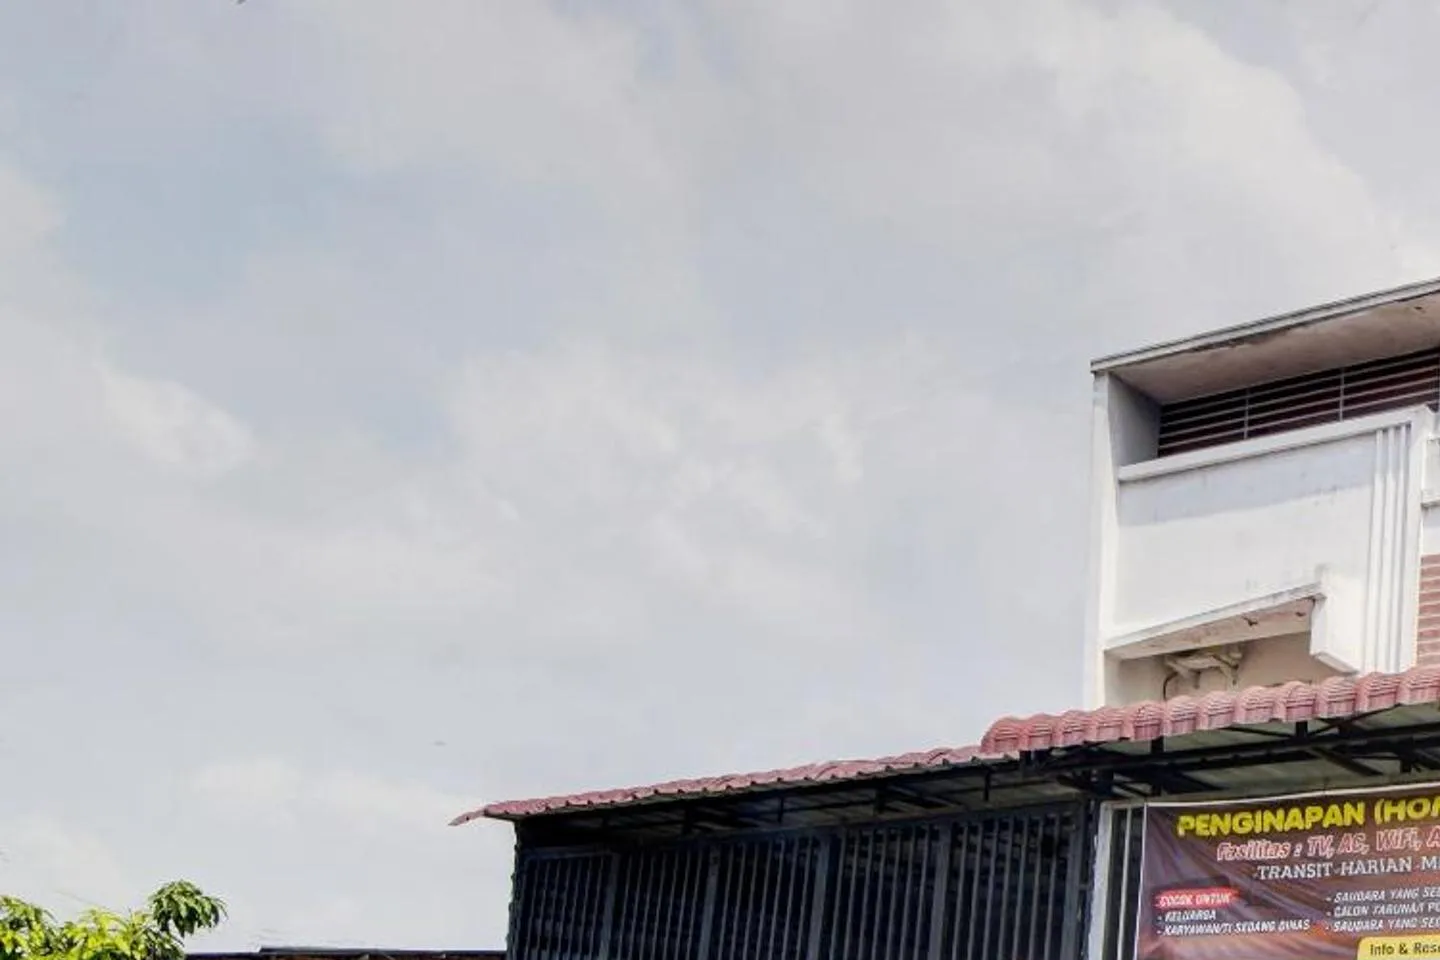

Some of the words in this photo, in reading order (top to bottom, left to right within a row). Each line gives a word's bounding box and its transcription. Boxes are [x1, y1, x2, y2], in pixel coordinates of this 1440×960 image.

[1176, 801, 1366, 837] PENGINAPAN
[1217, 838, 1291, 861] Fasilitas
[1257, 862, 1334, 880] TRANSIT
[1334, 890, 1385, 903] SAUDARA
[1390, 887, 1420, 900] YANG
[1334, 905, 1369, 917] CALON
[1388, 918, 1418, 930] YANG
[1370, 943, 1395, 956] Info
[1399, 943, 1409, 955] &
